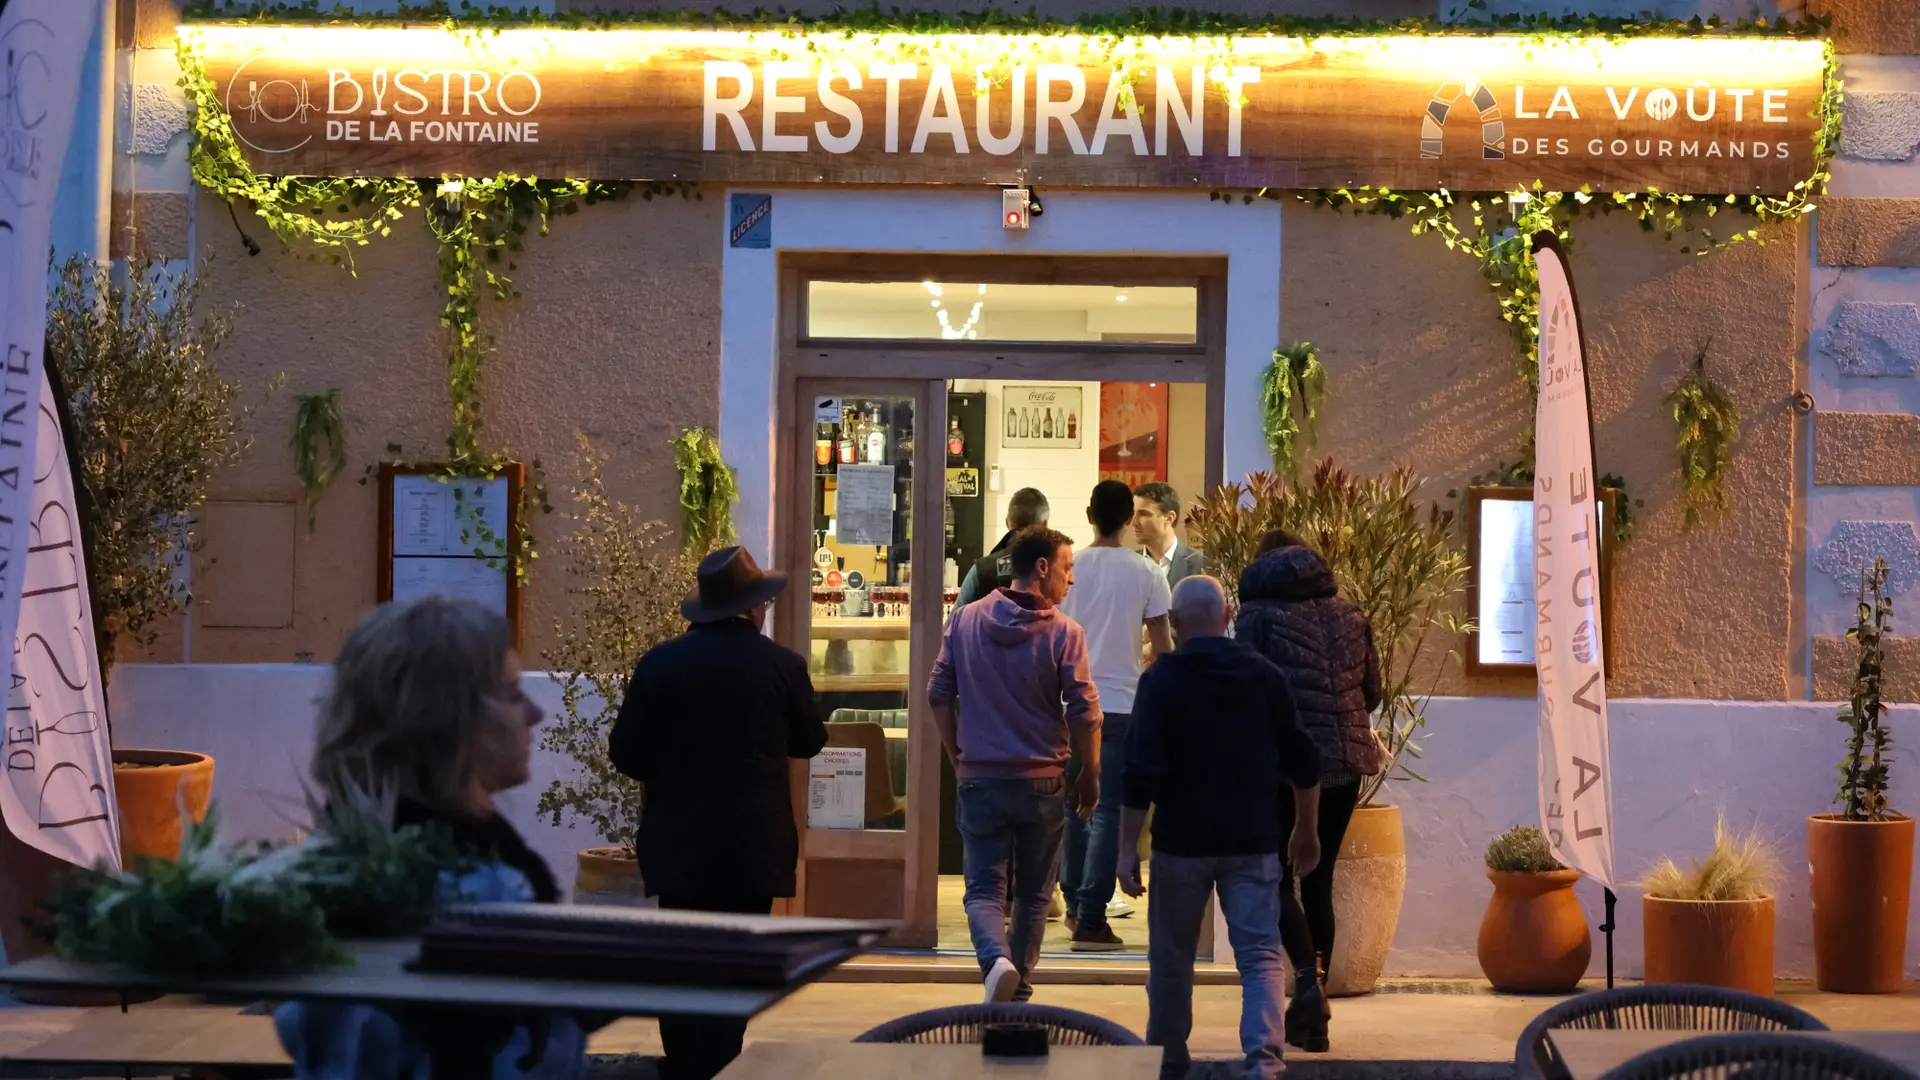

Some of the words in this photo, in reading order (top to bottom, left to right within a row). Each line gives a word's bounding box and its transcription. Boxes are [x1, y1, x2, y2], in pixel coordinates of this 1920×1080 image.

[326, 69, 542, 116] BISTRO
[703, 60, 1261, 157] RESTAURANT
[1514, 85, 1580, 121] LA
[1606, 80, 1789, 124] VOÛTE
[326, 121, 361, 142] DE
[370, 121, 402, 142] LA
[409, 121, 540, 142] FONTAINE
[1513, 137, 1570, 156] DES
[1588, 138, 1791, 160] GOURMANDS
[733, 200, 769, 241] LICENCE
[819, 553, 832, 563] IPA
